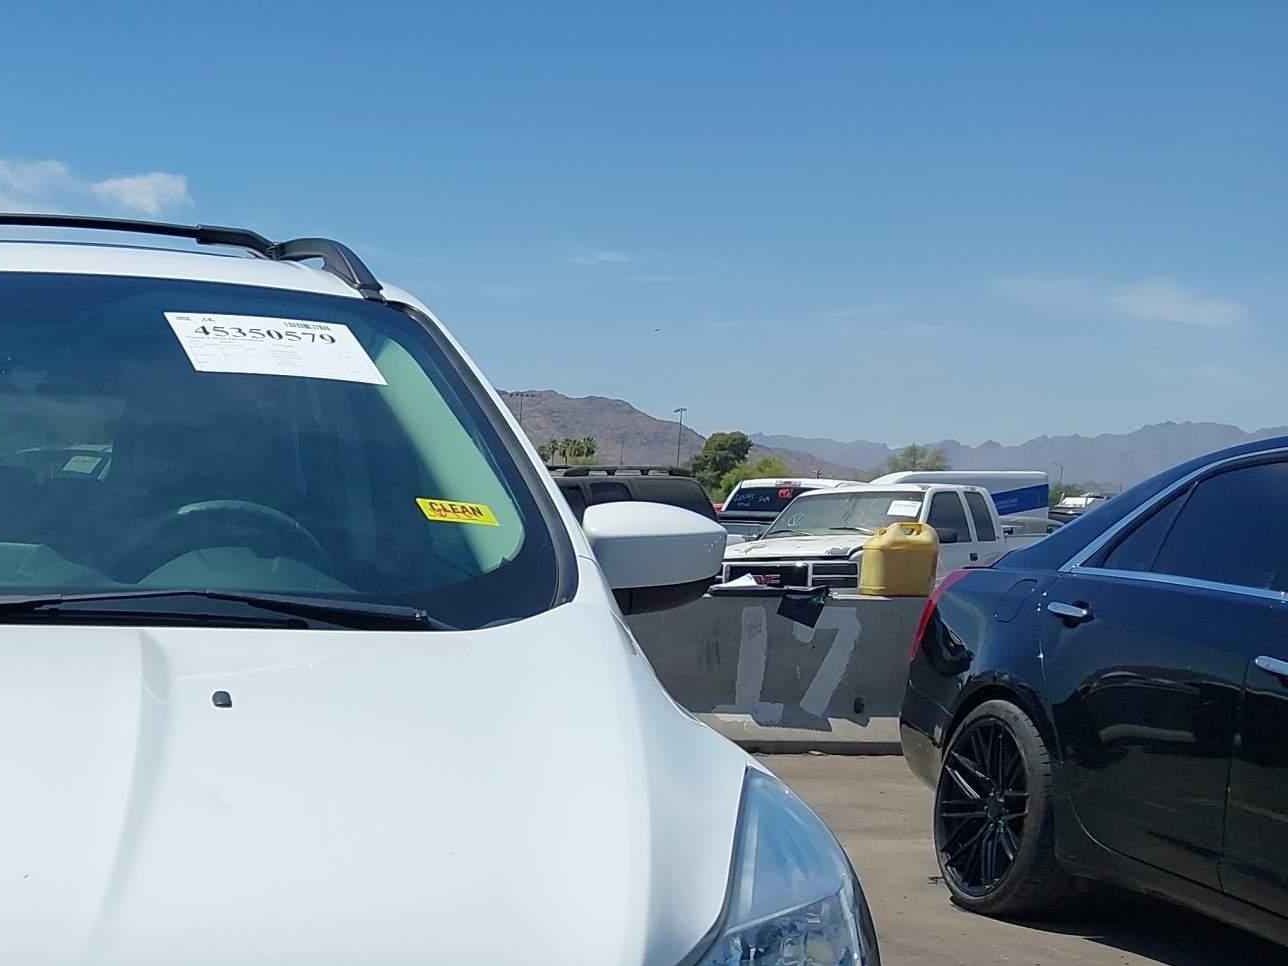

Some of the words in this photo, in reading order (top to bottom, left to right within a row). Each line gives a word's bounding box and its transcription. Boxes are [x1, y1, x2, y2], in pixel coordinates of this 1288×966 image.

[194, 324, 337, 344] 45350579
[428, 501, 484, 517] CLEAN
[711, 605, 862, 724] 17
